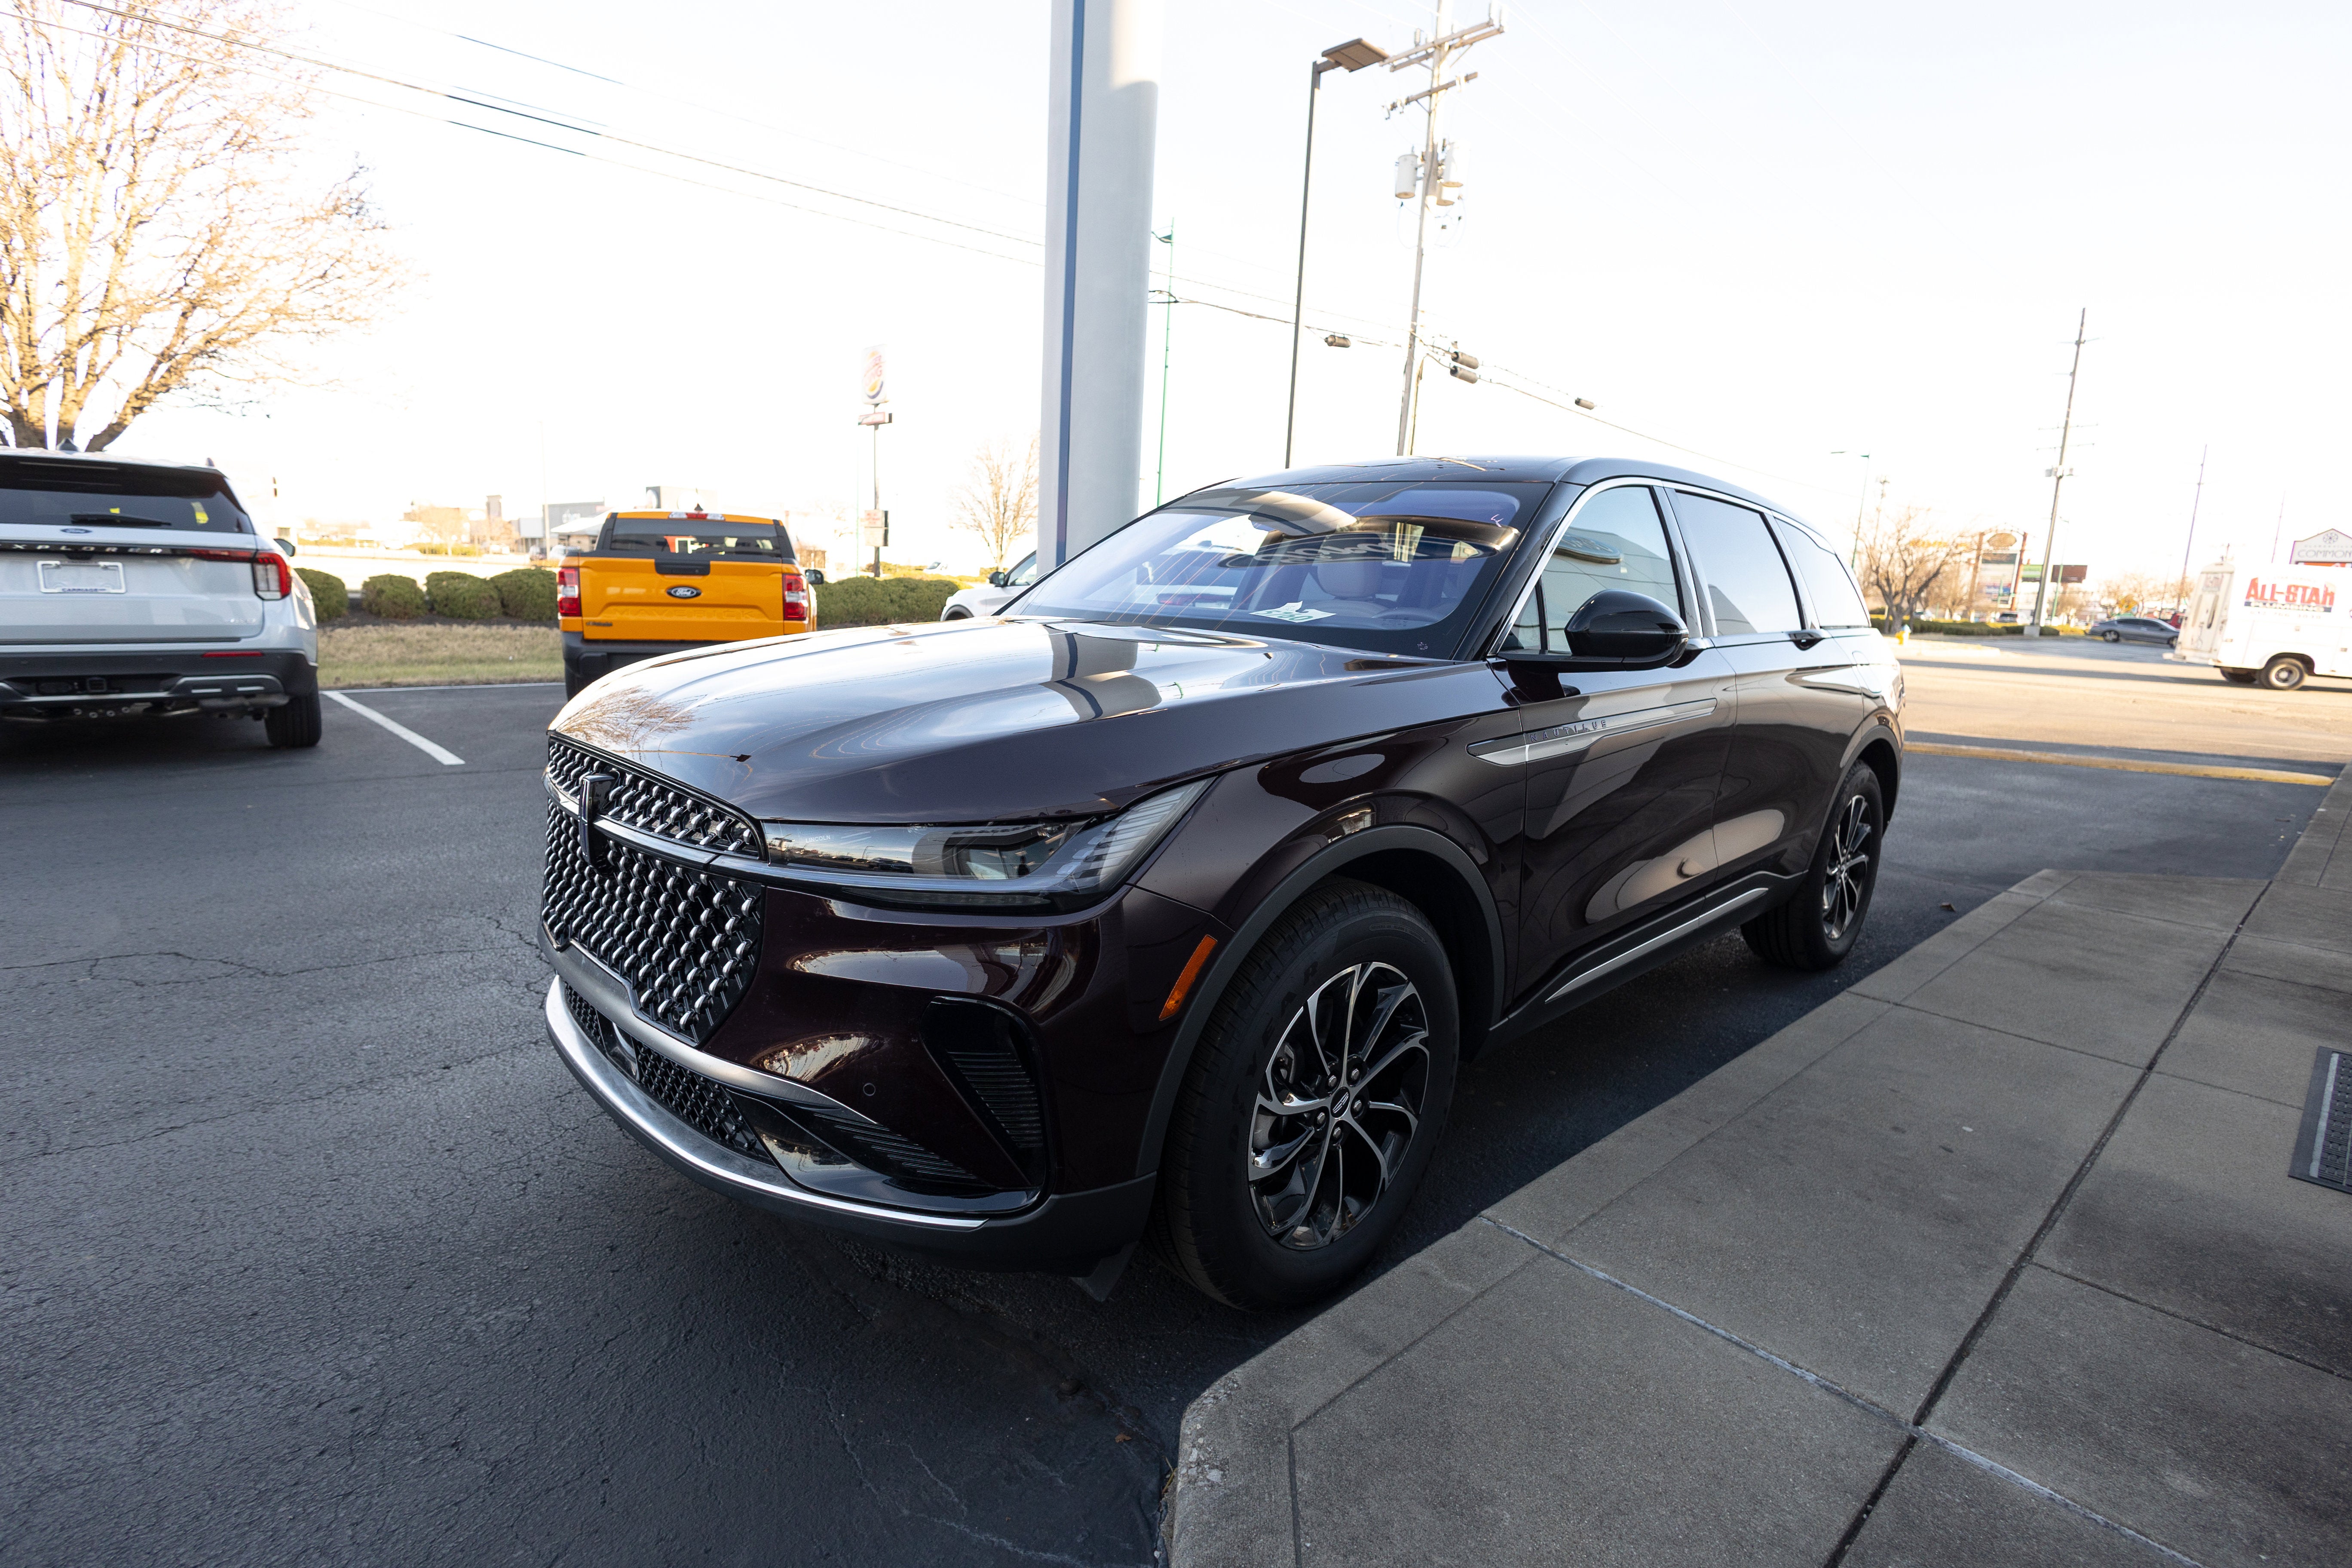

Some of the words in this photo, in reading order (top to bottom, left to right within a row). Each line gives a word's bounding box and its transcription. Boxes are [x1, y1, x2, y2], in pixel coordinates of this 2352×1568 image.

[0, 544, 162, 554] XPLORER
[2245, 577, 2336, 606] ALL-STAR
[1530, 720, 1607, 742] NAUTILUS
[805, 835, 831, 843] LINCOLN
